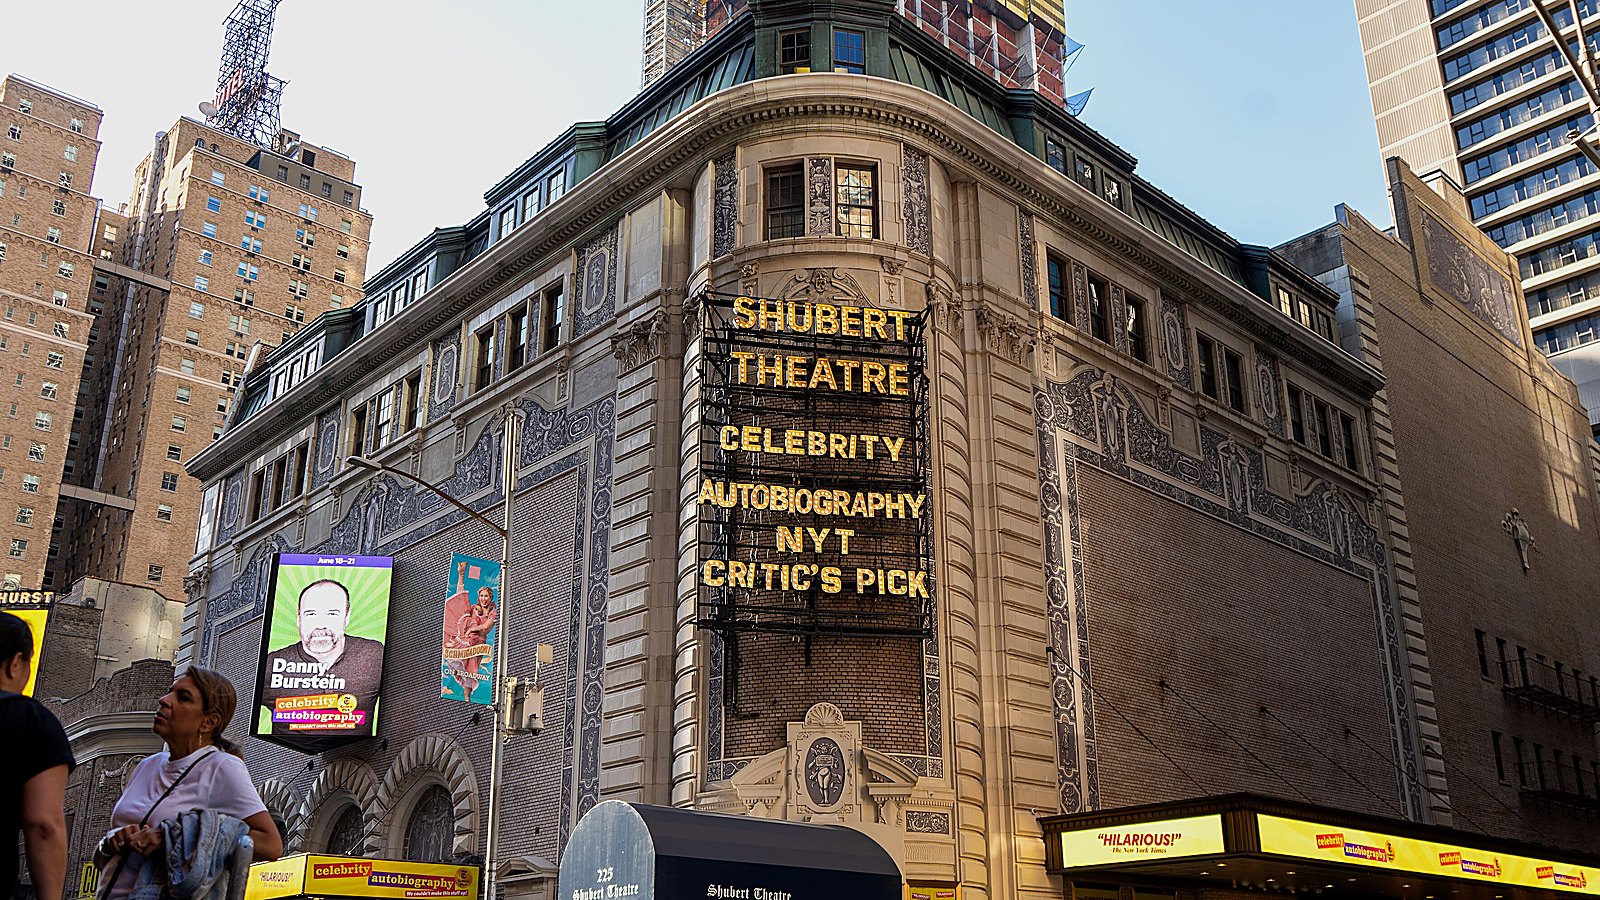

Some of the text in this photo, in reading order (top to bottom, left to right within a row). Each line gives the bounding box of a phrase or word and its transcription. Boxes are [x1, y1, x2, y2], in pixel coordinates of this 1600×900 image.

[732, 296, 910, 341] SHUBERT
[731, 351, 909, 396] THEATRE
[719, 425, 905, 462] CELEBRITY
[699, 479, 925, 519] AUTOBIOGRAPHY
[776, 525, 855, 555] NYT
[318, 556, 334, 564] June
[703, 559, 929, 599] CRITIC'S PICK
[0, 591, 54, 604] HURST
[444, 645, 491, 658] SCHMIGADOON!
[272, 658, 327, 676] Danny
[270, 673, 346, 690] Burstein
[457, 670, 490, 681] BROADWAY
[278, 696, 336, 709] celebrity
[275, 711, 364, 723] autobiography
[1097, 833, 1182, 847] "HILARIOUS!"
[1317, 835, 1343, 847] celebrity
[1345, 845, 1386, 862] autobiography
[1440, 852, 1462, 864] celebrity
[316, 864, 371, 876] celebrity
[597, 866, 614, 883] 225
[1462, 861, 1495, 877] autobiography
[371, 874, 454, 890] autobiography
[572, 883, 639, 900] Shubert Theatre
[707, 883, 792, 900] Shubert Theatre
